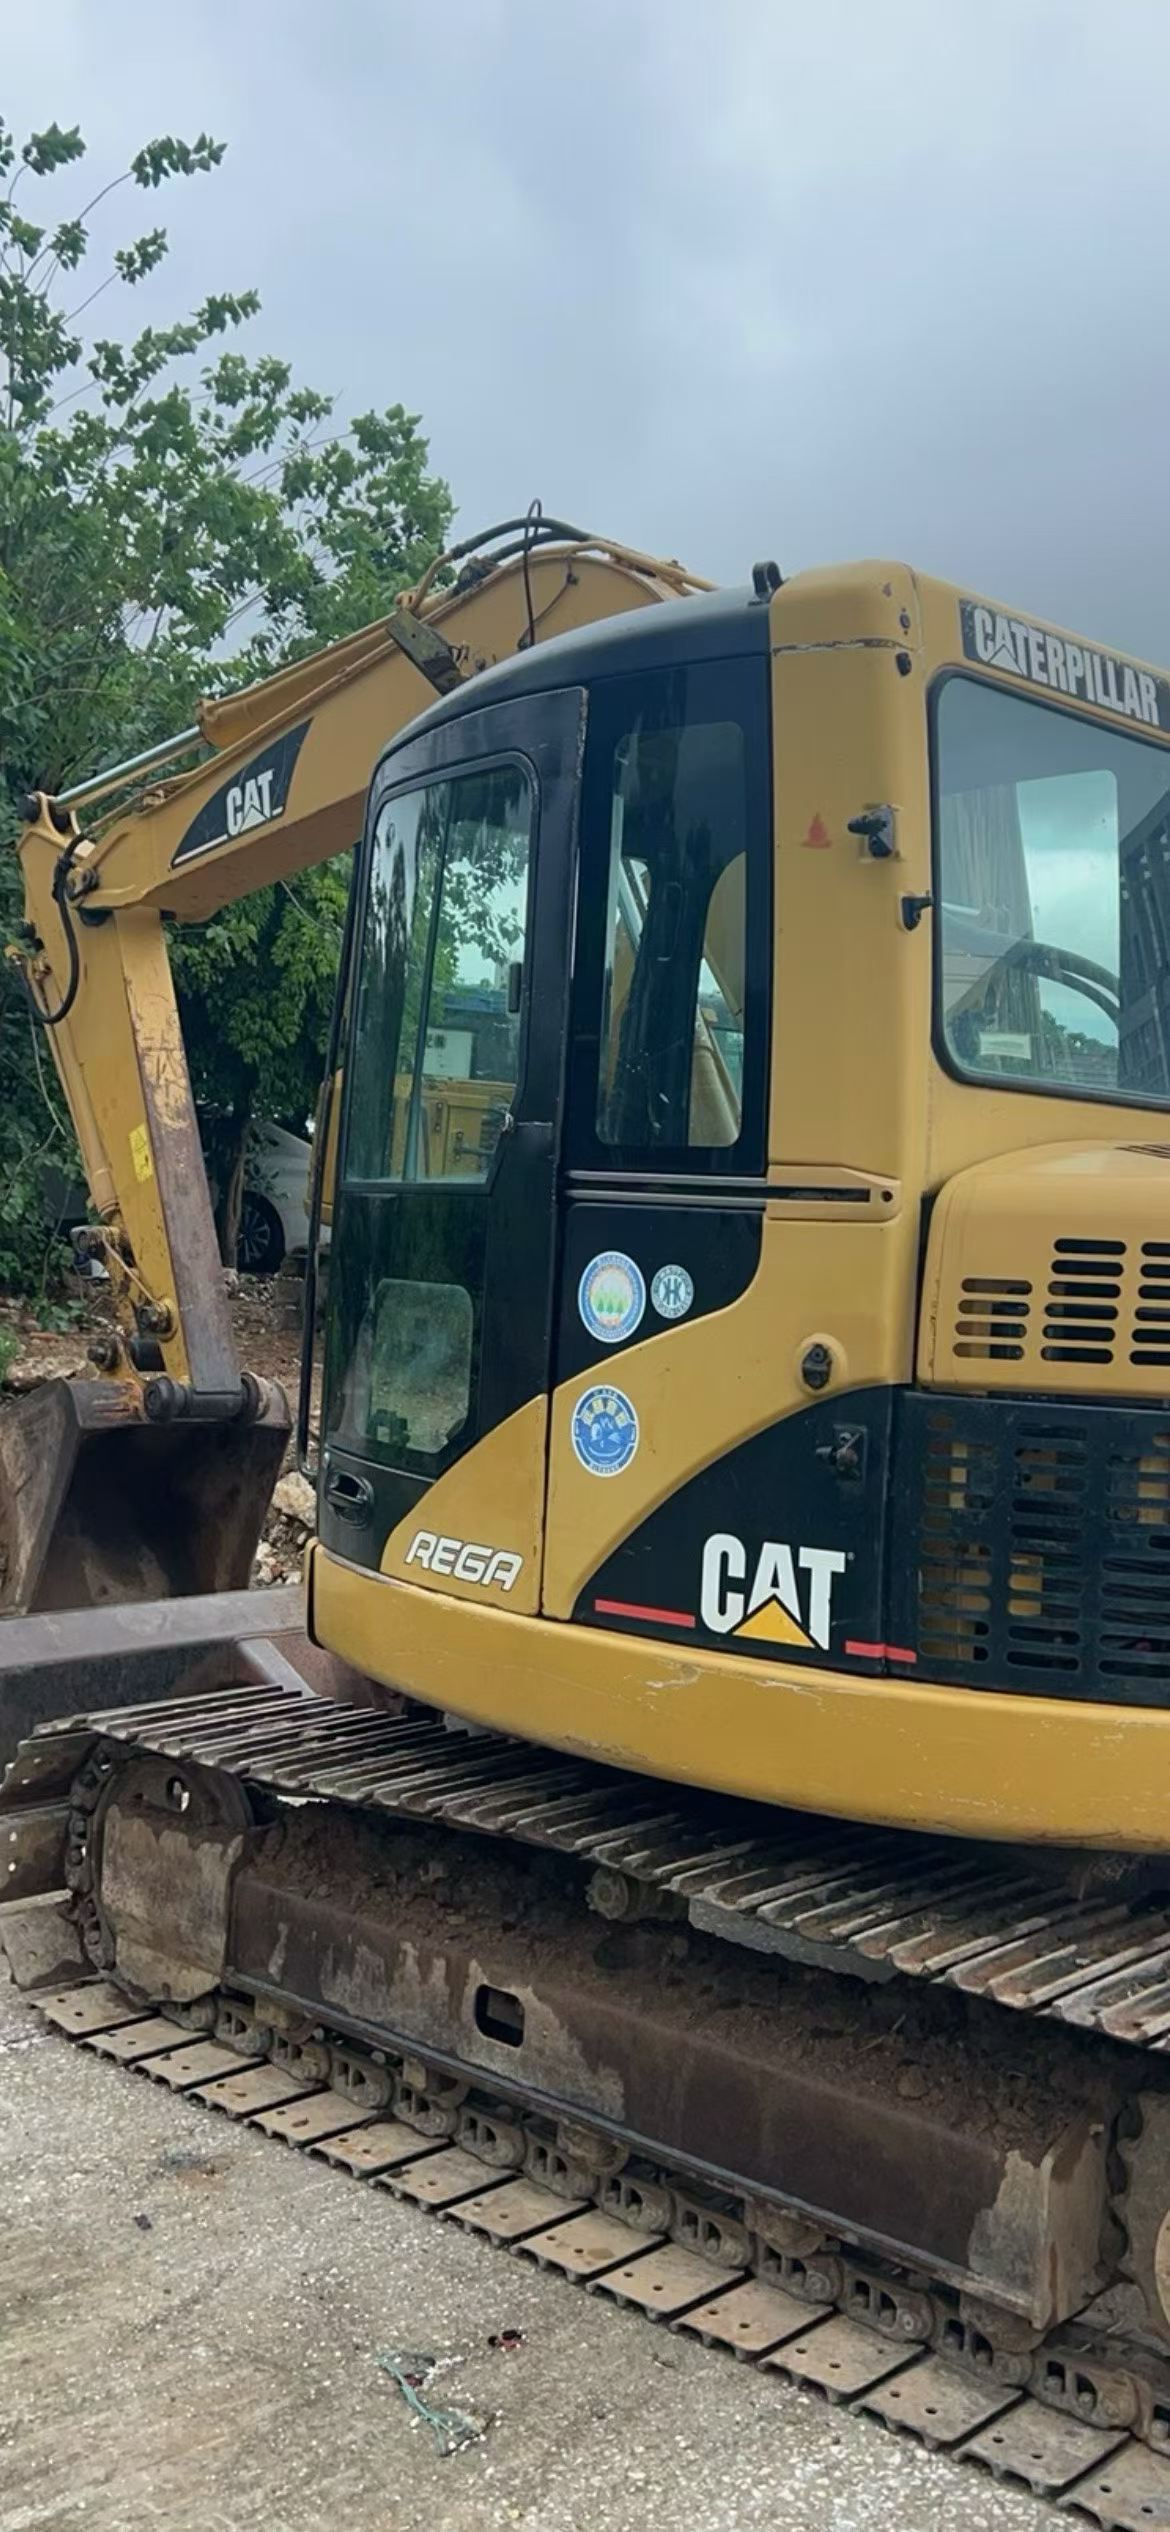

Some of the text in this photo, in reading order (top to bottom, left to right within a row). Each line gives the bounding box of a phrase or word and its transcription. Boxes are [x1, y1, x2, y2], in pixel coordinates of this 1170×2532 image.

[974, 608, 1160, 726] CATERPILLAR
[226, 767, 274, 836] CAT
[404, 1530, 523, 1592] REGA
[701, 1533, 846, 1650] CAT
